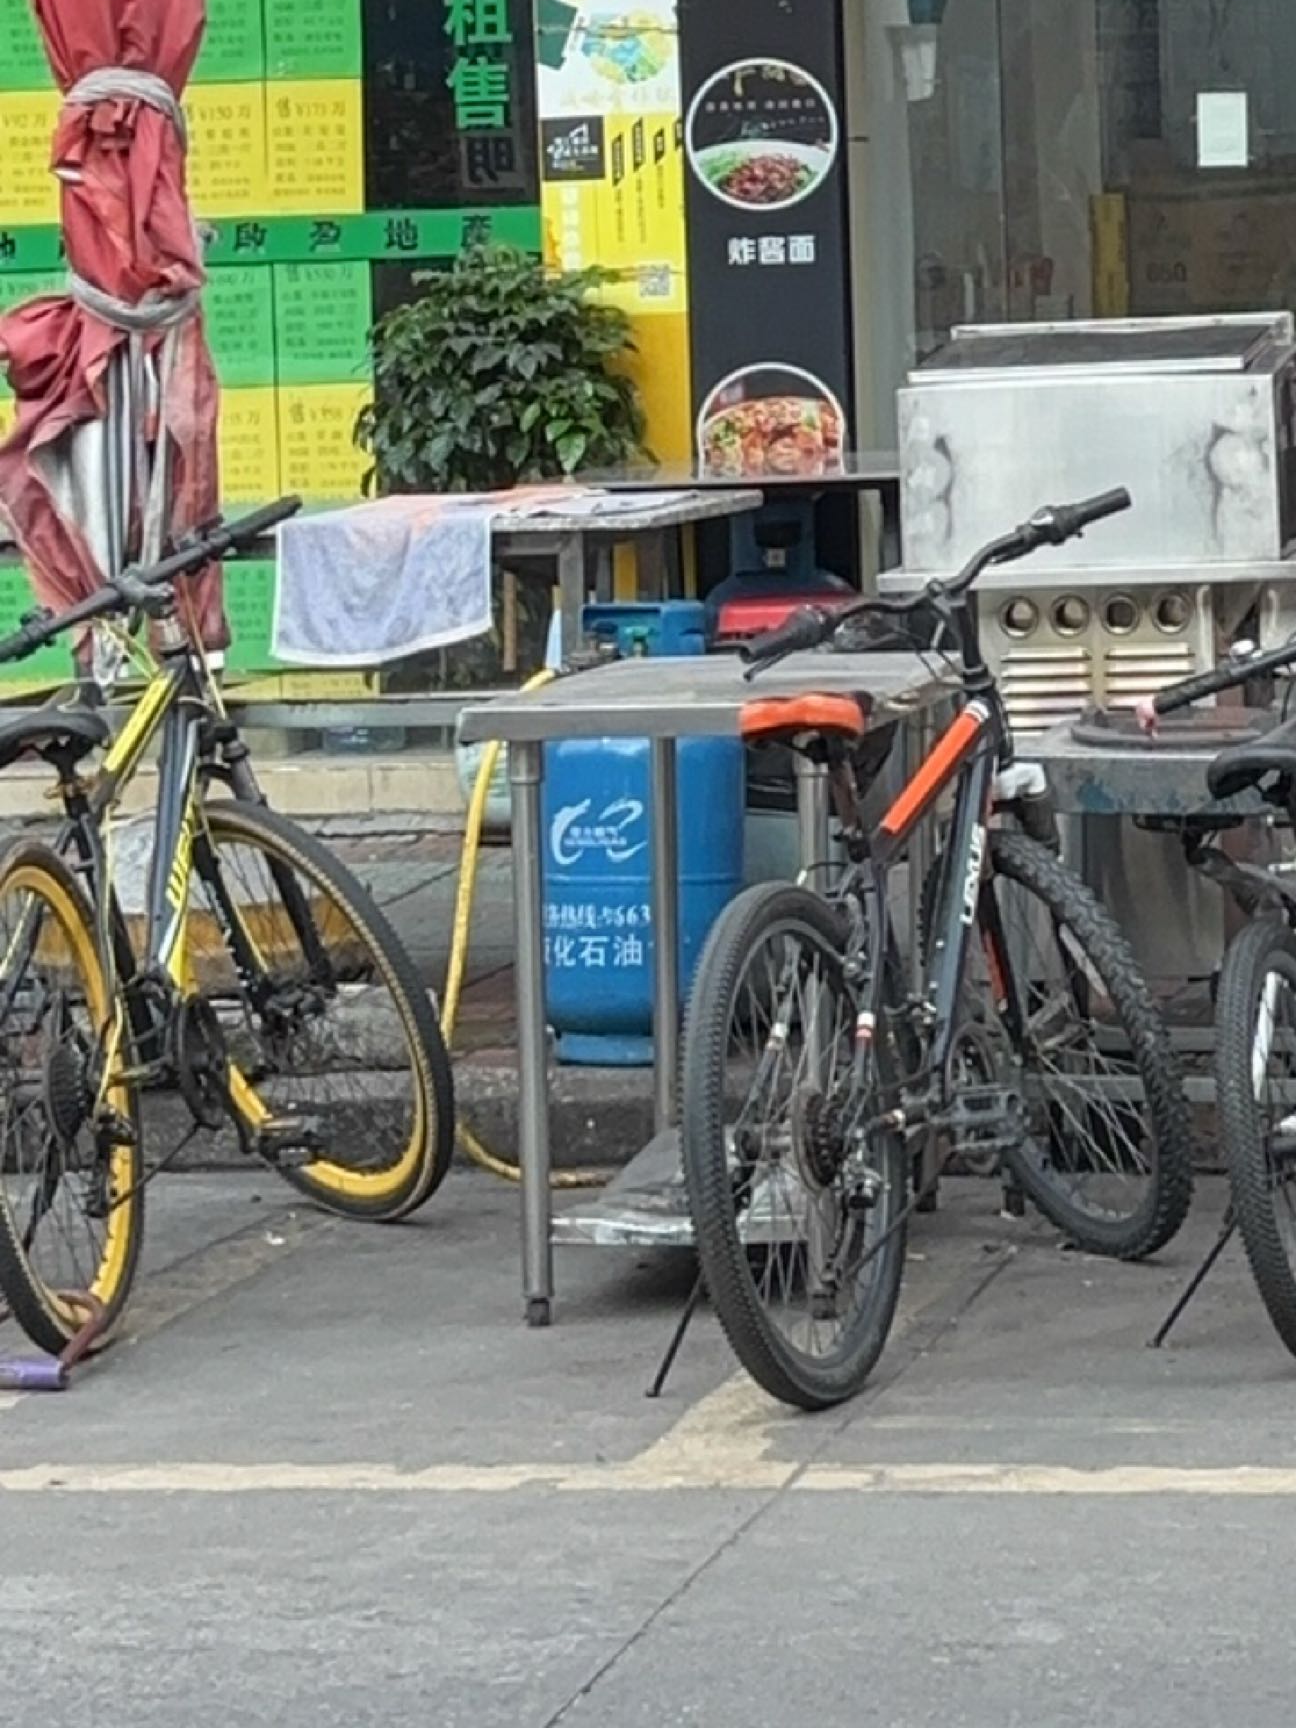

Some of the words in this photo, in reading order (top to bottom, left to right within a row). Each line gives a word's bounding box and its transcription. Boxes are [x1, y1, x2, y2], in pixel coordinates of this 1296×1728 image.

[727, 235, 816, 266] 炸酱面
[543, 932, 657, 968] 化石油
